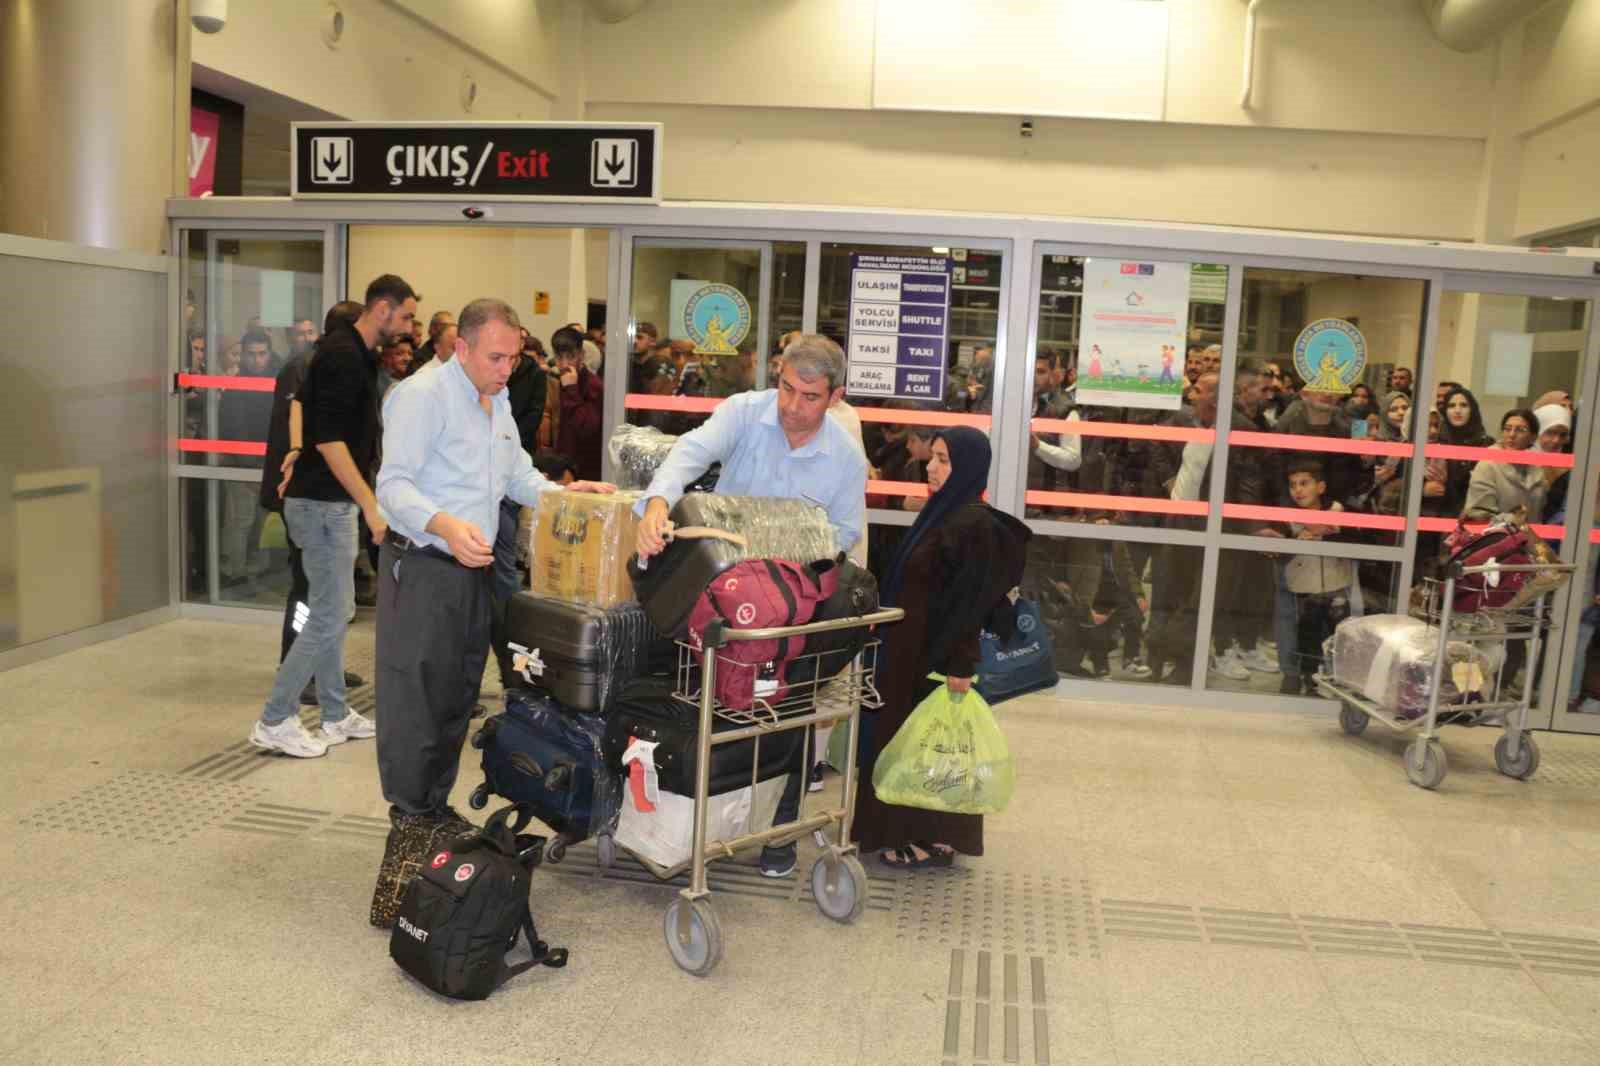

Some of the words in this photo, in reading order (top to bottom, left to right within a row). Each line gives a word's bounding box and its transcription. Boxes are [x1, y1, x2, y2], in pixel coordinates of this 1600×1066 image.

[857, 280, 899, 290] ULAŞIM
[858, 308, 894, 317] YOLCU
[855, 318, 897, 328] SERVİSİ
[902, 316, 942, 325] SHUTTLE
[858, 344, 890, 354] TAKSİ
[908, 347, 934, 357] TAXI
[860, 371, 883, 380] ARAÇ
[906, 373, 931, 383] RENT
[904, 384, 912, 393] A
[912, 385, 931, 394] CAR
